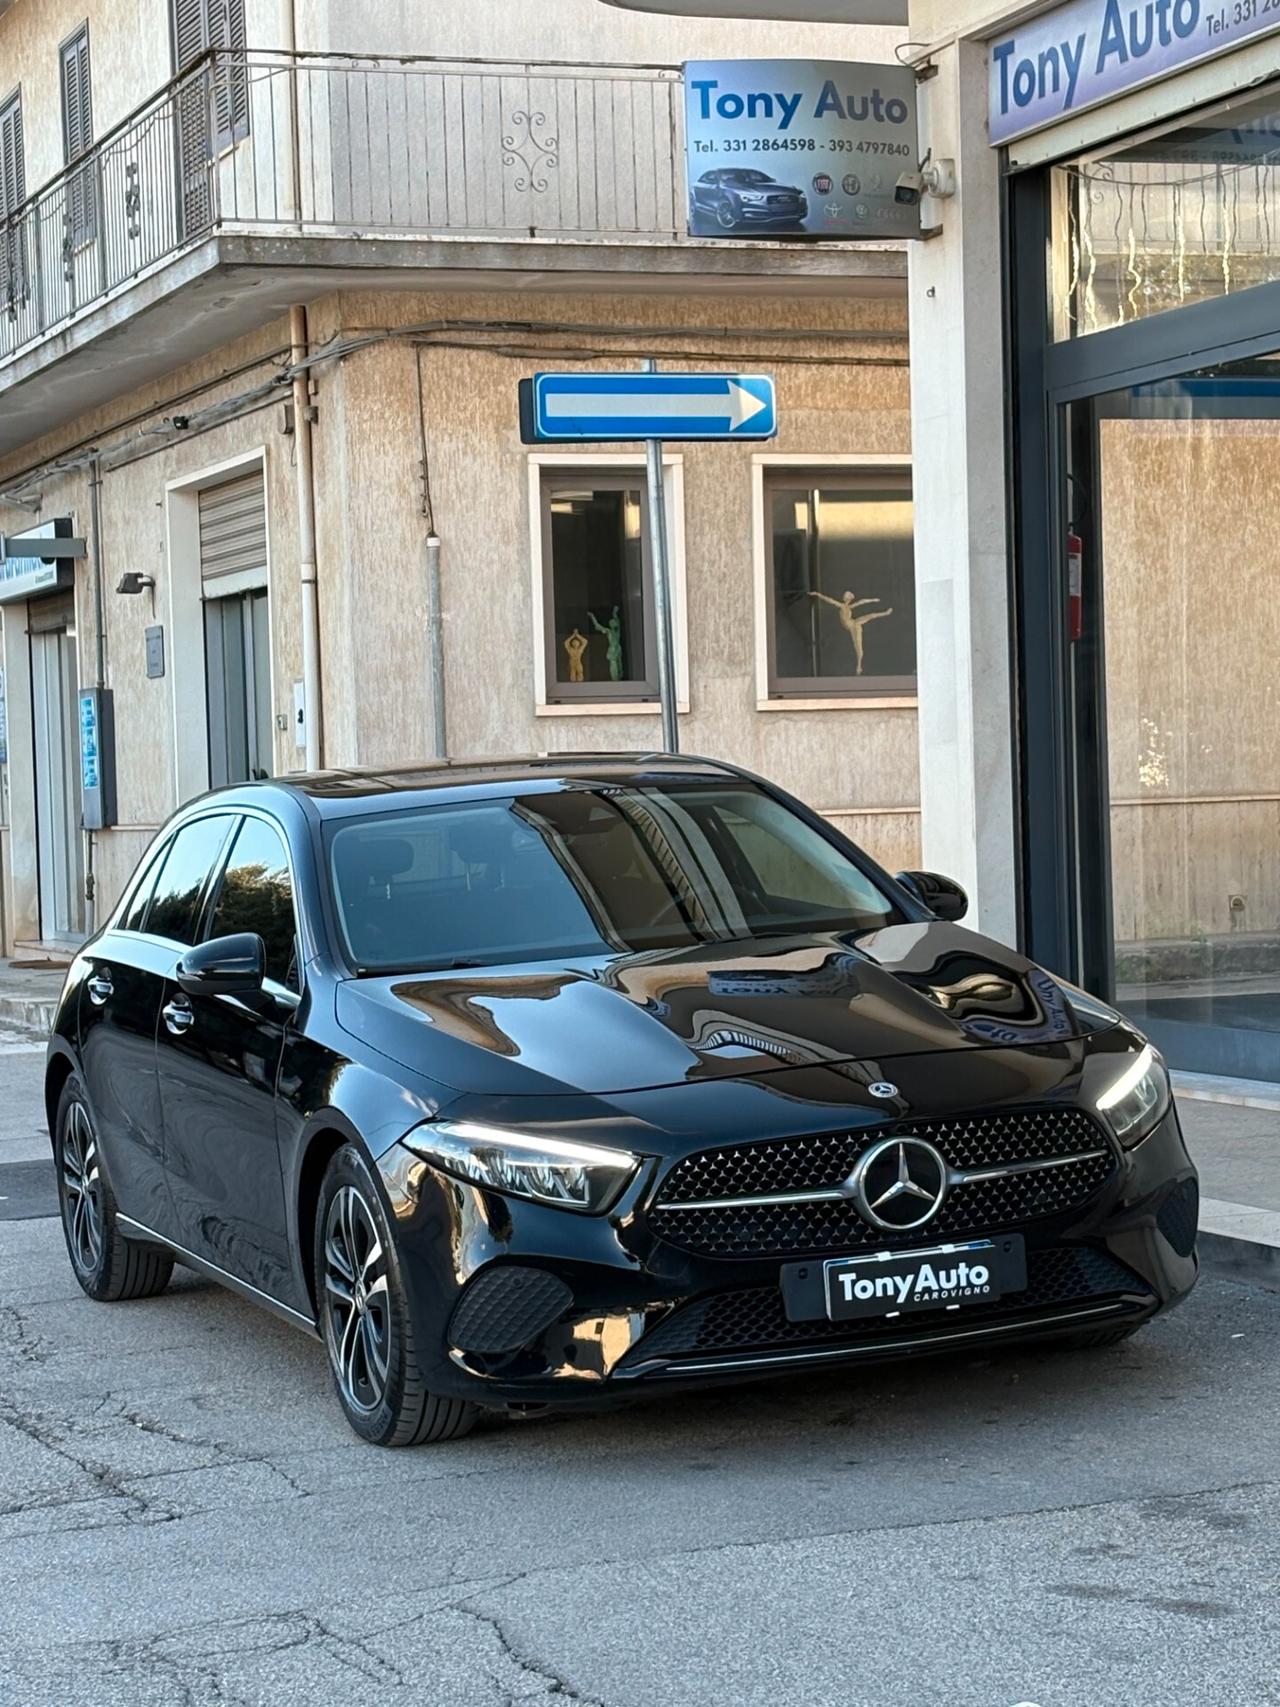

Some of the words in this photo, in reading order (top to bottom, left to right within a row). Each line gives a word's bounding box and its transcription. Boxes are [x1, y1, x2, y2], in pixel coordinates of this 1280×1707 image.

[1206, 8, 1229, 37] Tel.
[1233, 0, 1257, 25] 331
[992, 33, 1086, 116] Tony
[1096, 0, 1200, 74] Auto
[691, 80, 803, 130] Tony
[813, 80, 908, 124] Auto
[694, 140, 719, 153] Tel.
[723, 140, 747, 152] 331
[752, 139, 816, 152] 2864598
[829, 140, 853, 152] 393
[856, 141, 910, 157] 4797840
[838, 1262, 990, 1304] TonyAuto
[914, 1285, 991, 1302] CAROVIGNO
